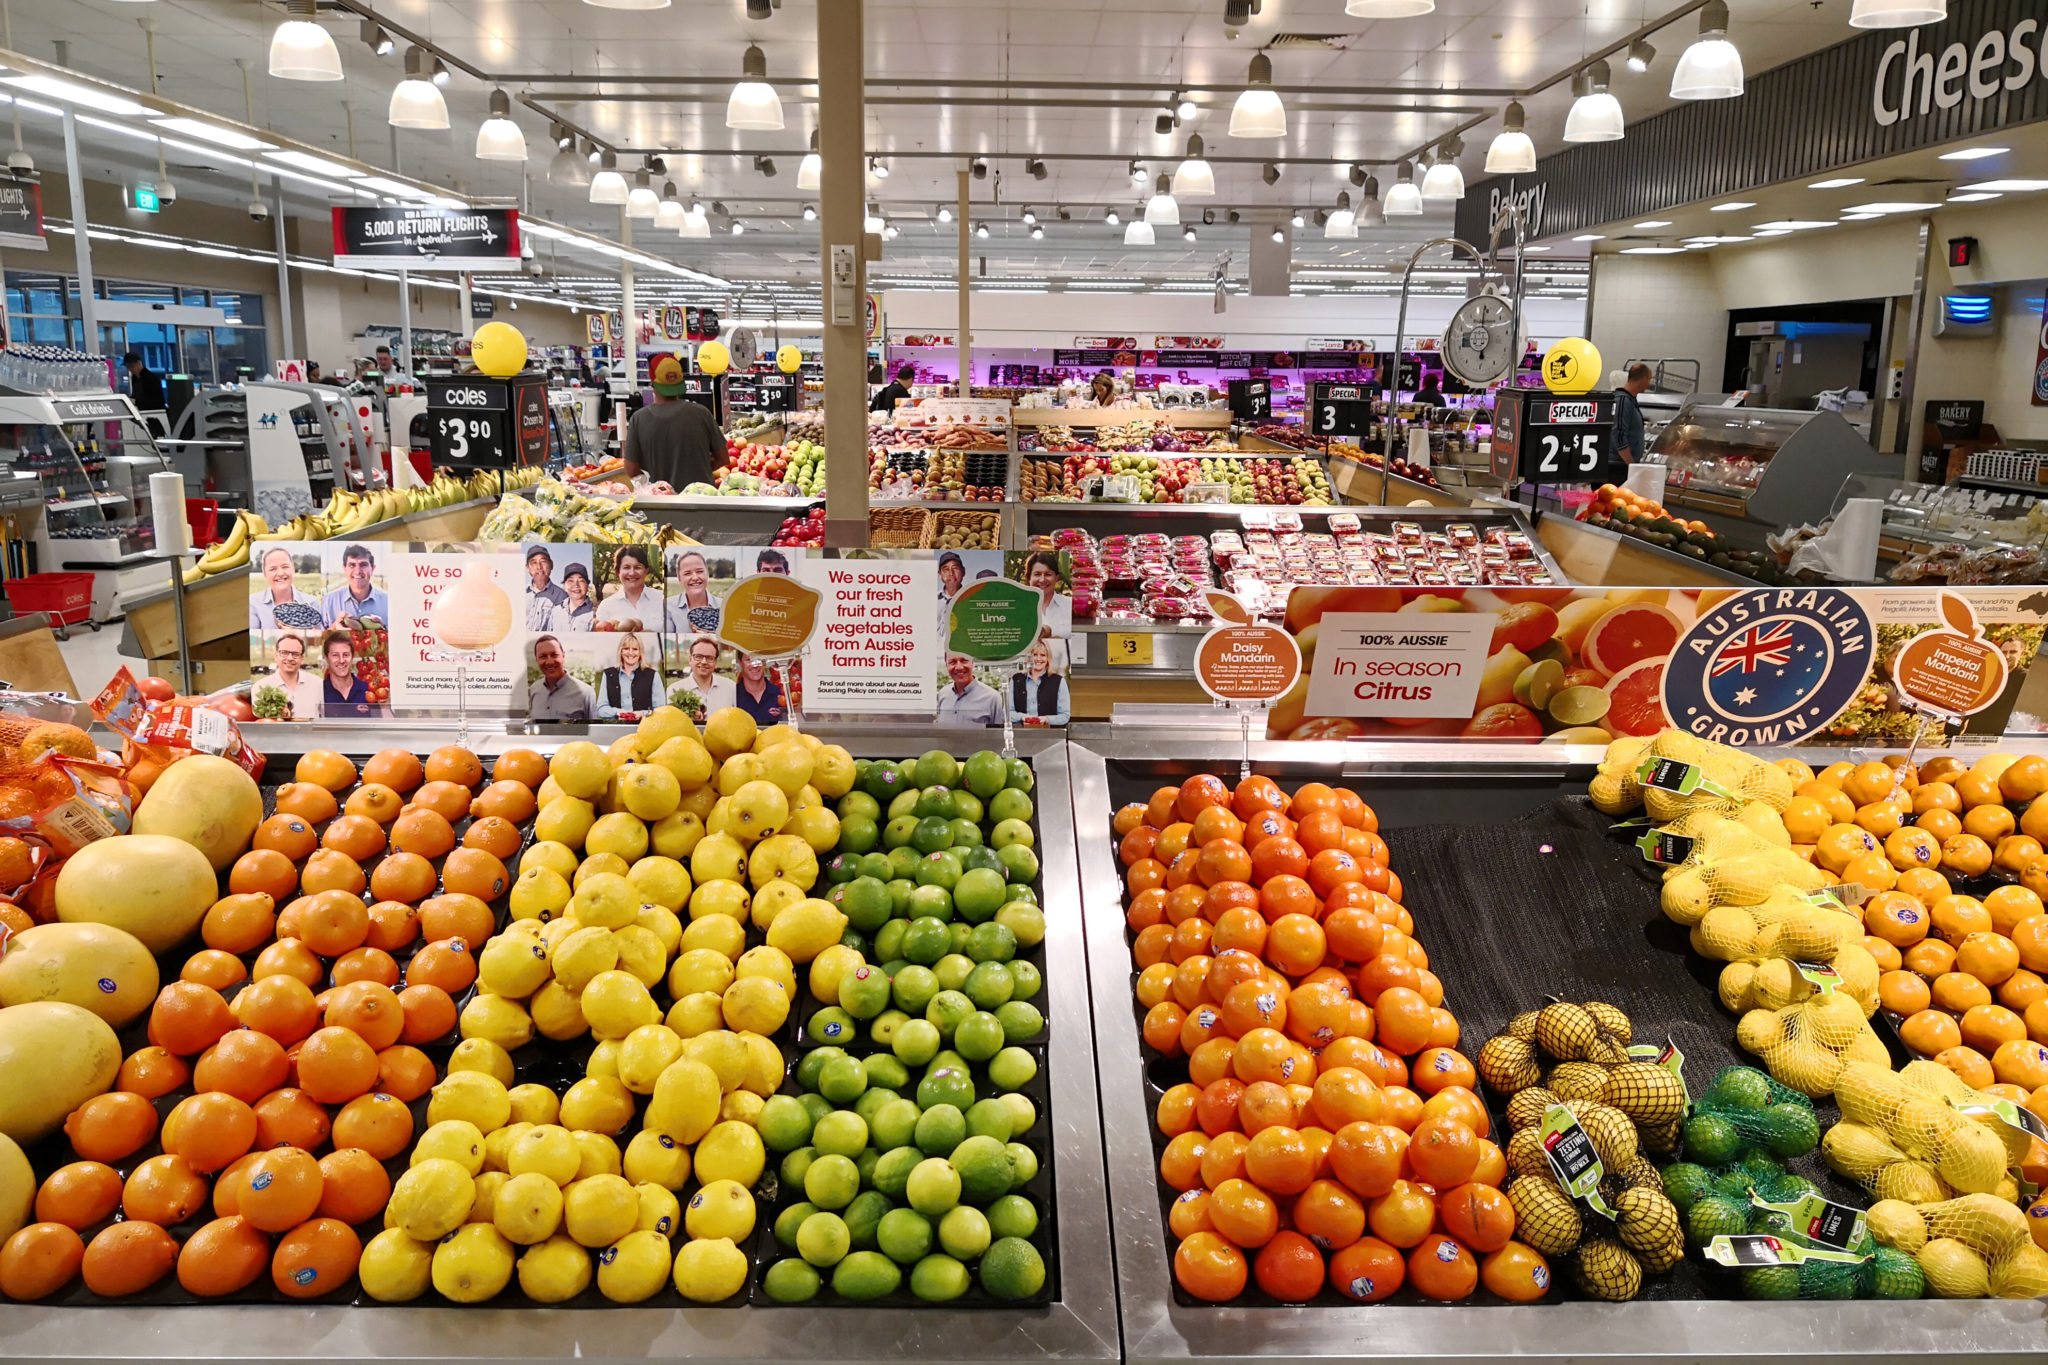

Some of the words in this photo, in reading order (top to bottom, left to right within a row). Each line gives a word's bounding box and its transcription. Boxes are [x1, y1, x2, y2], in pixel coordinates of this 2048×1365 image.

[1873, 18, 2048, 127] Chees
[140, 193, 154, 209] EXIT
[1489, 177, 1549, 237] Bakery
[364, 221, 394, 238] 5,000
[397, 218, 441, 235] RETURN
[445, 215, 489, 232] FLIGHTS
[403, 235, 413, 246] in
[1957, 244, 1966, 264] 6
[591, 316, 602, 330] 1/2
[610, 312, 622, 328] 1/2
[667, 310, 681, 325] 1/2
[667, 325, 682, 334] PRICE
[763, 376, 785, 384] SPECIAL
[445, 386, 488, 406] coles
[1330, 389, 1359, 398] SPECIAL
[70, 404, 90, 415] Cold
[89, 403, 114, 415] drinks
[1552, 405, 1595, 418] SPECIAL
[1939, 407, 1971, 419] BAKERY
[1321, 405, 1336, 430] 3
[1539, 434, 1560, 472] 2
[1562, 444, 1572, 453] for
[1922, 455, 1938, 467] BAKERY
[415, 565, 440, 578] We
[828, 571, 854, 584] We
[858, 573, 911, 585] source
[422, 584, 446, 595] ou
[836, 590, 862, 601] our
[866, 588, 903, 601] fresh
[751, 605, 787, 619] Lemon
[836, 604, 866, 617] fruit
[870, 605, 902, 618] and
[981, 613, 1006, 623] Lime
[826, 621, 913, 637] vegetables
[1689, 589, 1865, 656] AUSTRALIAN
[824, 637, 860, 650] from
[864, 638, 915, 651] Aussie
[1233, 642, 1264, 654] Daisy
[1359, 635, 1395, 646] 100%
[1398, 635, 1449, 646] AUSSIE
[1948, 639, 1962, 649] 100%
[832, 654, 876, 667] farms
[880, 655, 907, 668] first
[1221, 652, 1275, 663] Mandarin
[1934, 648, 1982, 672] Imperial
[1333, 657, 1357, 676] In
[1364, 661, 1462, 676] season
[1924, 656, 1979, 683] Mandarin
[818, 687, 847, 695] Sourcing
[848, 687, 866, 695] Policy
[1353, 681, 1432, 701] Citrus
[1690, 713, 1808, 747] GROWN
[1657, 761, 1672, 783] LEMONS
[1666, 836, 1674, 860] LEMONS
[1557, 1132, 1586, 1158] ZESTING
[1563, 1147, 1581, 1163] LEMONS
[1805, 1197, 1815, 1213] PACK
[1821, 1207, 1836, 1234] AUSTRALIAN
[1826, 1215, 1843, 1237] LIMES
